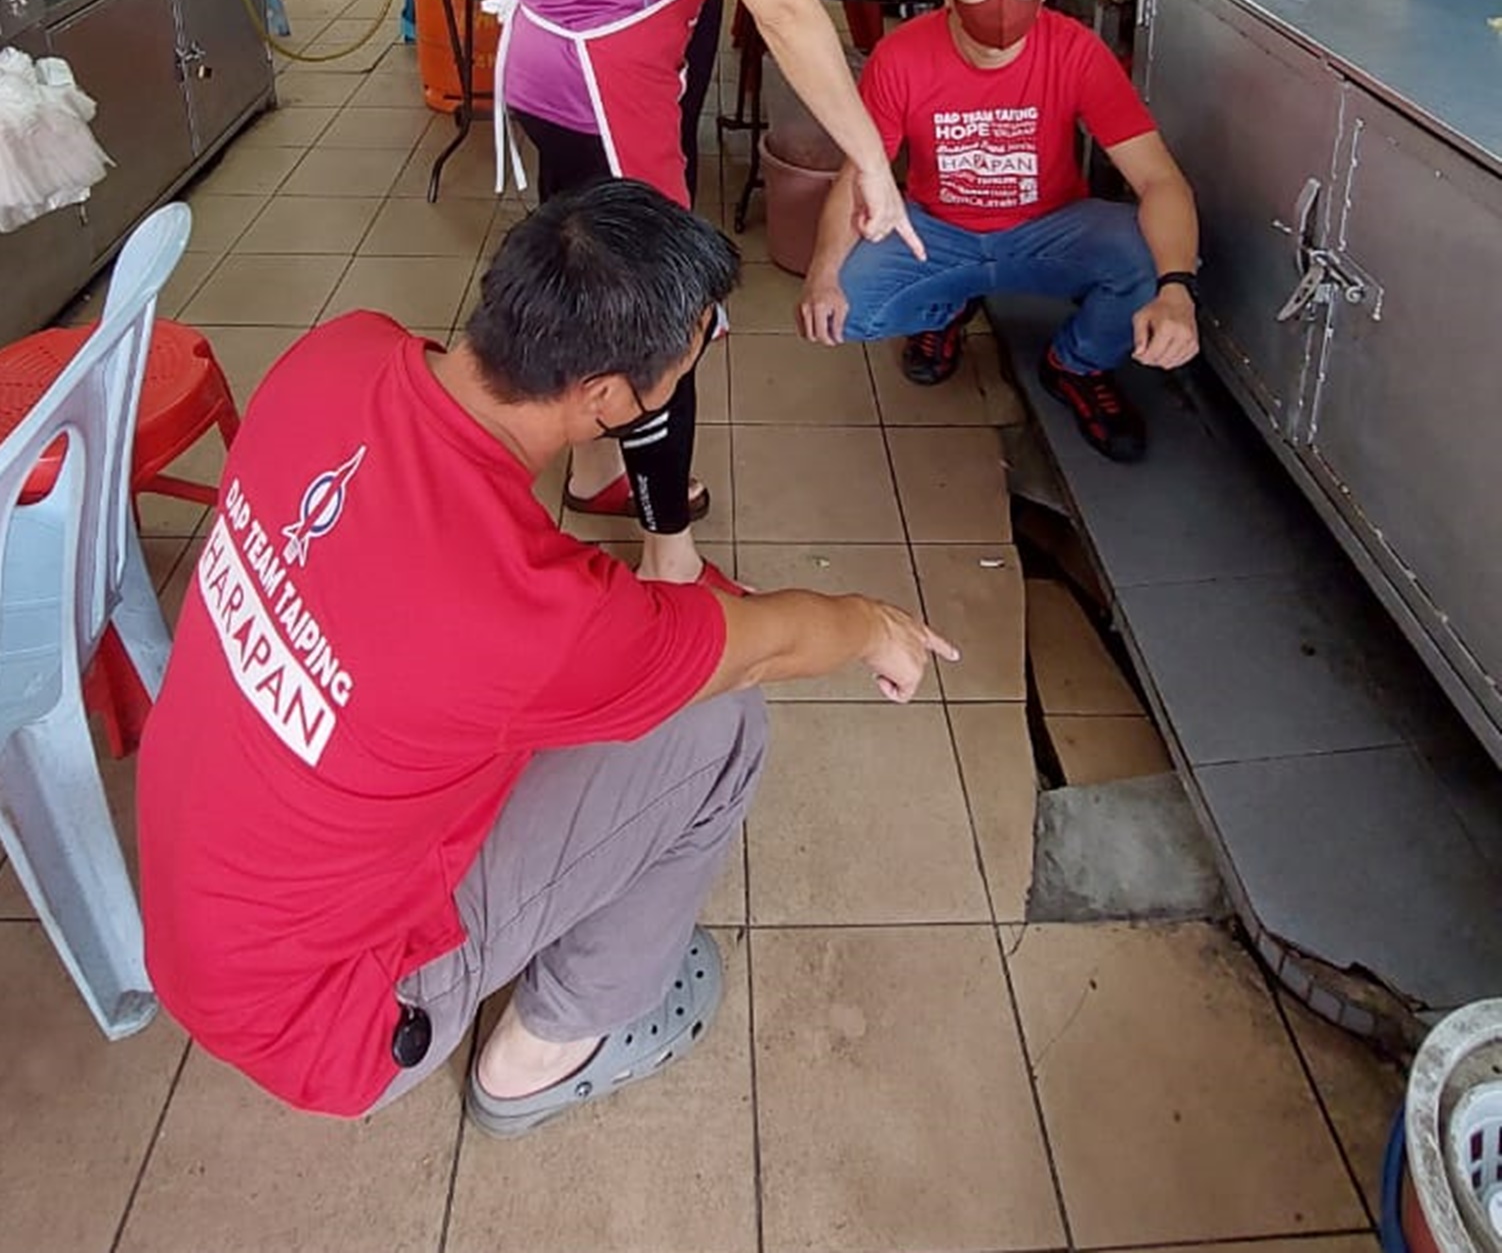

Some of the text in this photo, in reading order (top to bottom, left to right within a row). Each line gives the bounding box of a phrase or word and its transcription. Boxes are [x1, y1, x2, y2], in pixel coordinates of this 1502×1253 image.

[934, 112, 960, 125] DAP
[962, 110, 993, 125] TEAM
[936, 123, 990, 140] HOPE
[942, 153, 1033, 172] HARAPAN
[225, 478, 353, 707] DAP TEAM TAIPING
[203, 527, 326, 747] HARAPAN
